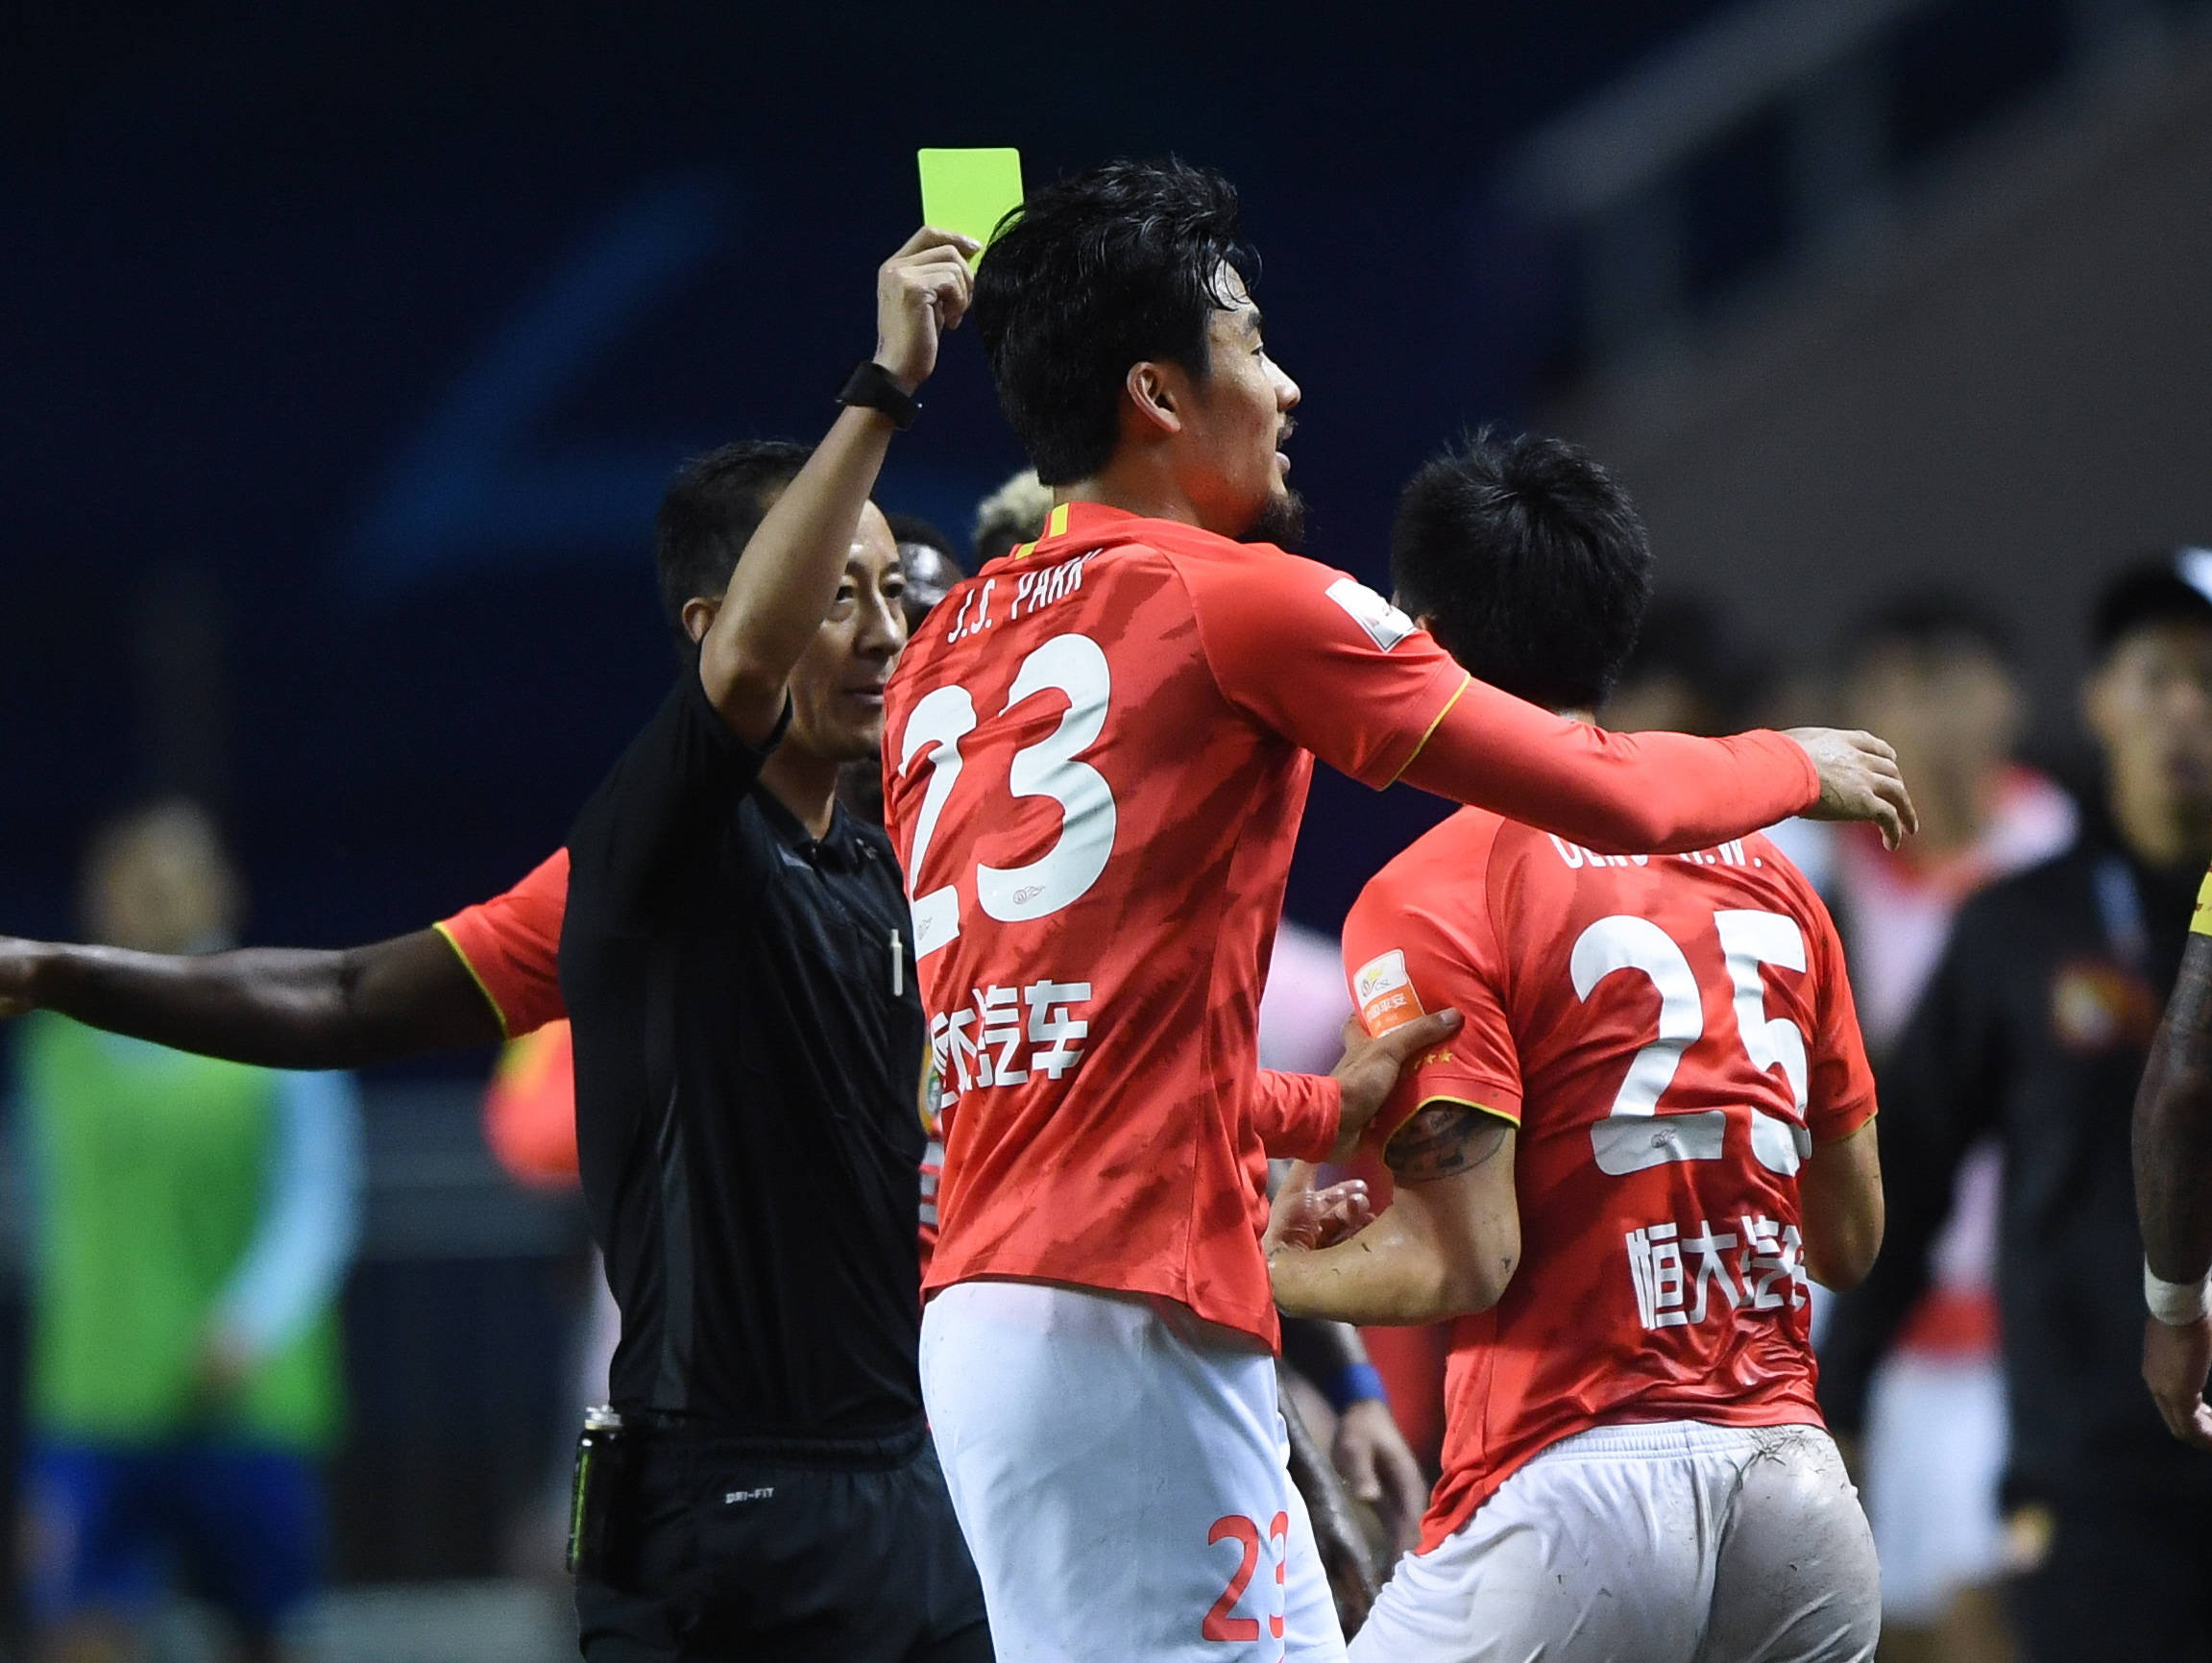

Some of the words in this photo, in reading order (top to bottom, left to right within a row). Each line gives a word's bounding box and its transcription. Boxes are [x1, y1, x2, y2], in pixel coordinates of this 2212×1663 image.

[897, 632, 1118, 963] 23
[1569, 909, 1812, 1178] 25
[725, 1487, 774, 1504] DRI-FIT
